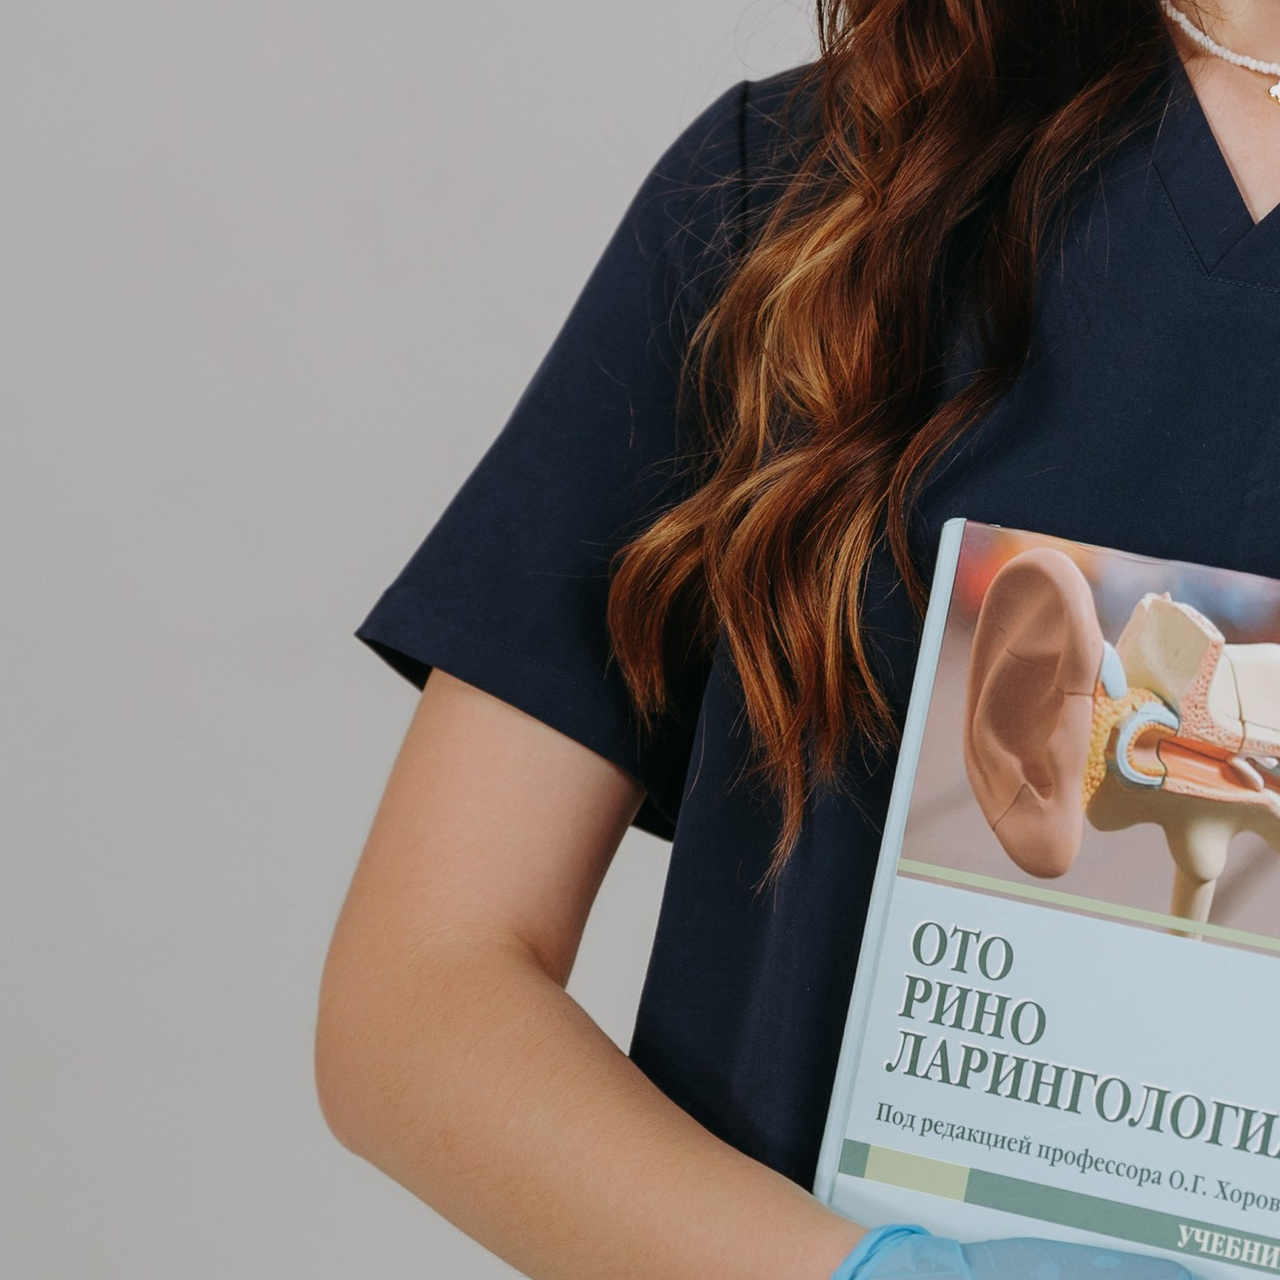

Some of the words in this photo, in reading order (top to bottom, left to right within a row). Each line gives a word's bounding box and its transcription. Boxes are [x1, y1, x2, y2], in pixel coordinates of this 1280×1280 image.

[912, 921, 1014, 981] ОТО
[898, 974, 1046, 1045] РИНО
[875, 1102, 916, 1132] Под
[919, 1116, 1033, 1156] редакцией
[1036, 1143, 1163, 1187] профессора
[1169, 1170, 1208, 1197] О.Г.
